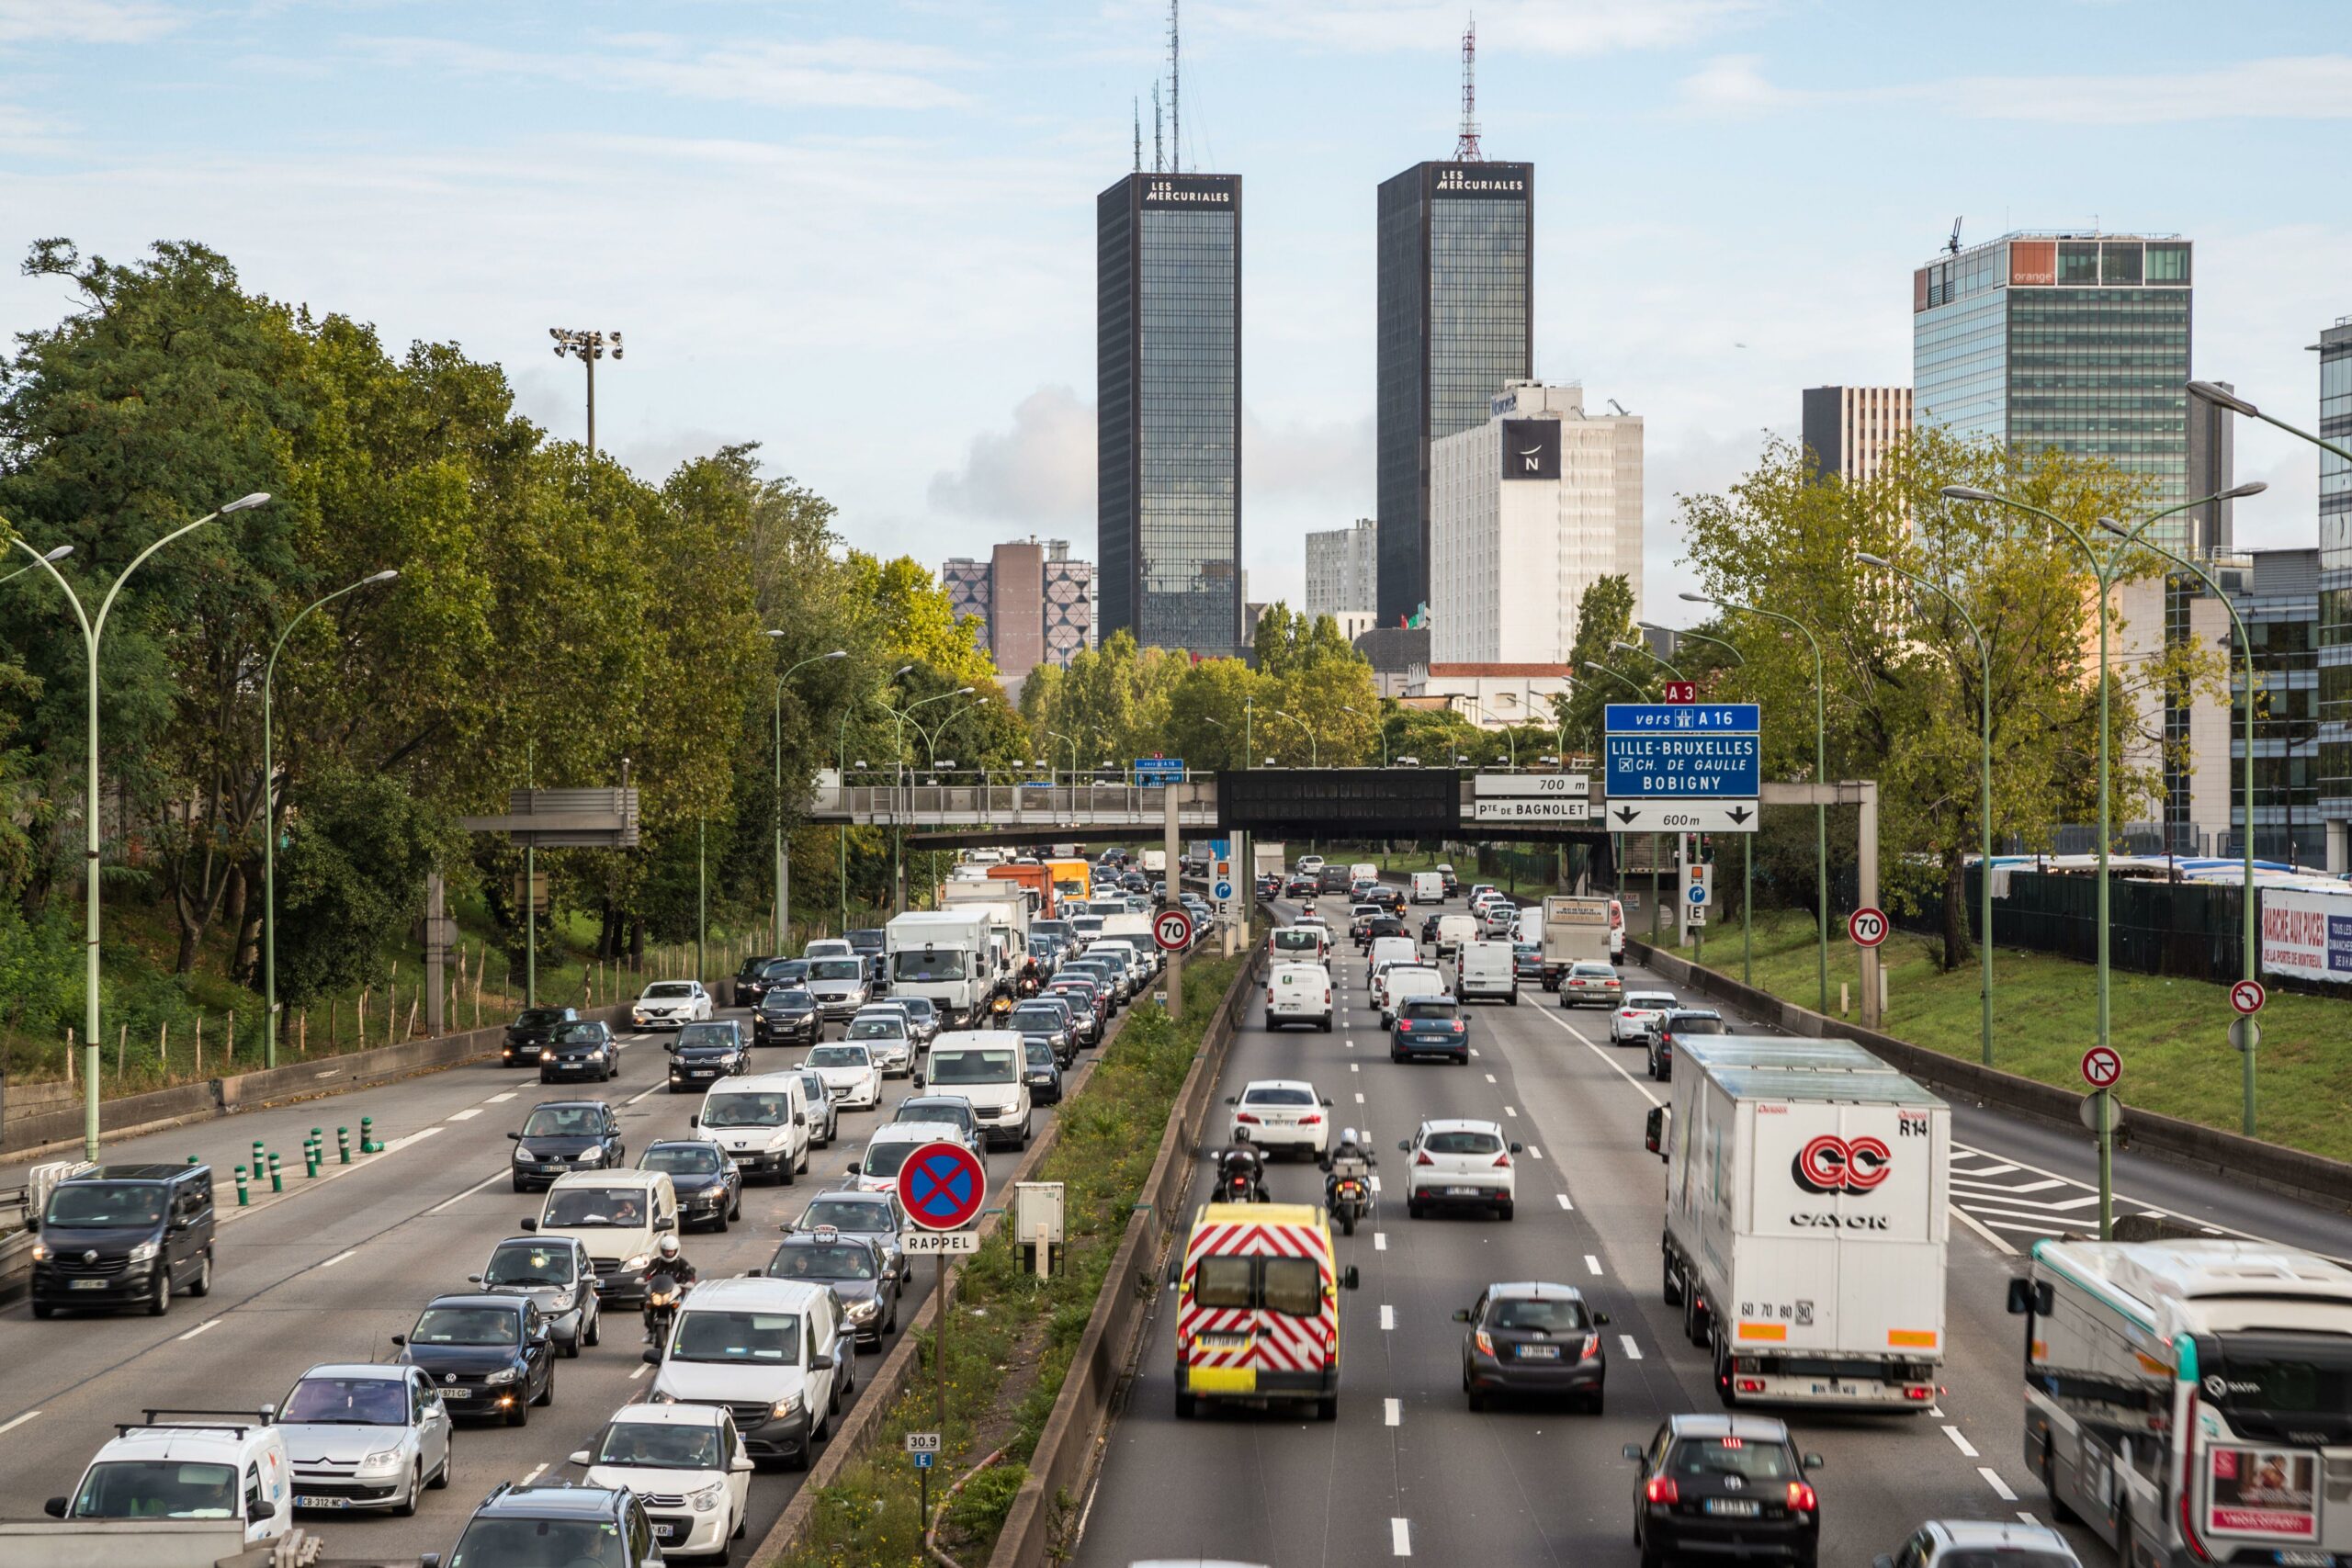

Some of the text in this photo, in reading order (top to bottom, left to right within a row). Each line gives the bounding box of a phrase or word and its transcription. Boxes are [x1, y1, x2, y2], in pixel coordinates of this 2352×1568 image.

[1442, 171, 1464, 180] LES
[1151, 182, 1171, 191] LES
[1436, 180, 1523, 190] MERCURIALES
[1146, 192, 1229, 202] MERCURIALES
[2014, 272, 2052, 283] orange
[1525, 457, 1538, 470] N
[1668, 686, 1693, 700] A 3
[1635, 712, 1733, 725] vers A 16
[1611, 741, 1753, 755] LILLE-BRUXELLES
[1635, 760, 1747, 771] CH. DE GAULLE
[1540, 779, 1586, 790] 700 m
[1644, 776, 1721, 790] BOBIGNY
[1516, 805, 1584, 815] BAGNOLET
[1663, 815, 1700, 826] 600 m
[1219, 902, 1227, 914] E
[1692, 907, 1701, 919] E
[1162, 922, 1184, 938] 70
[1858, 919, 1880, 934] 70
[2303, 911, 2324, 947] PUCES
[1898, 1119, 1928, 1137] R14
[1791, 1212, 1889, 1231] CAYON
[910, 1237, 969, 1249] RAPPEL
[1741, 1302, 1810, 1320] 60 70 80 90
[910, 1437, 937, 1447] 30.9
[920, 1454, 927, 1466] E
